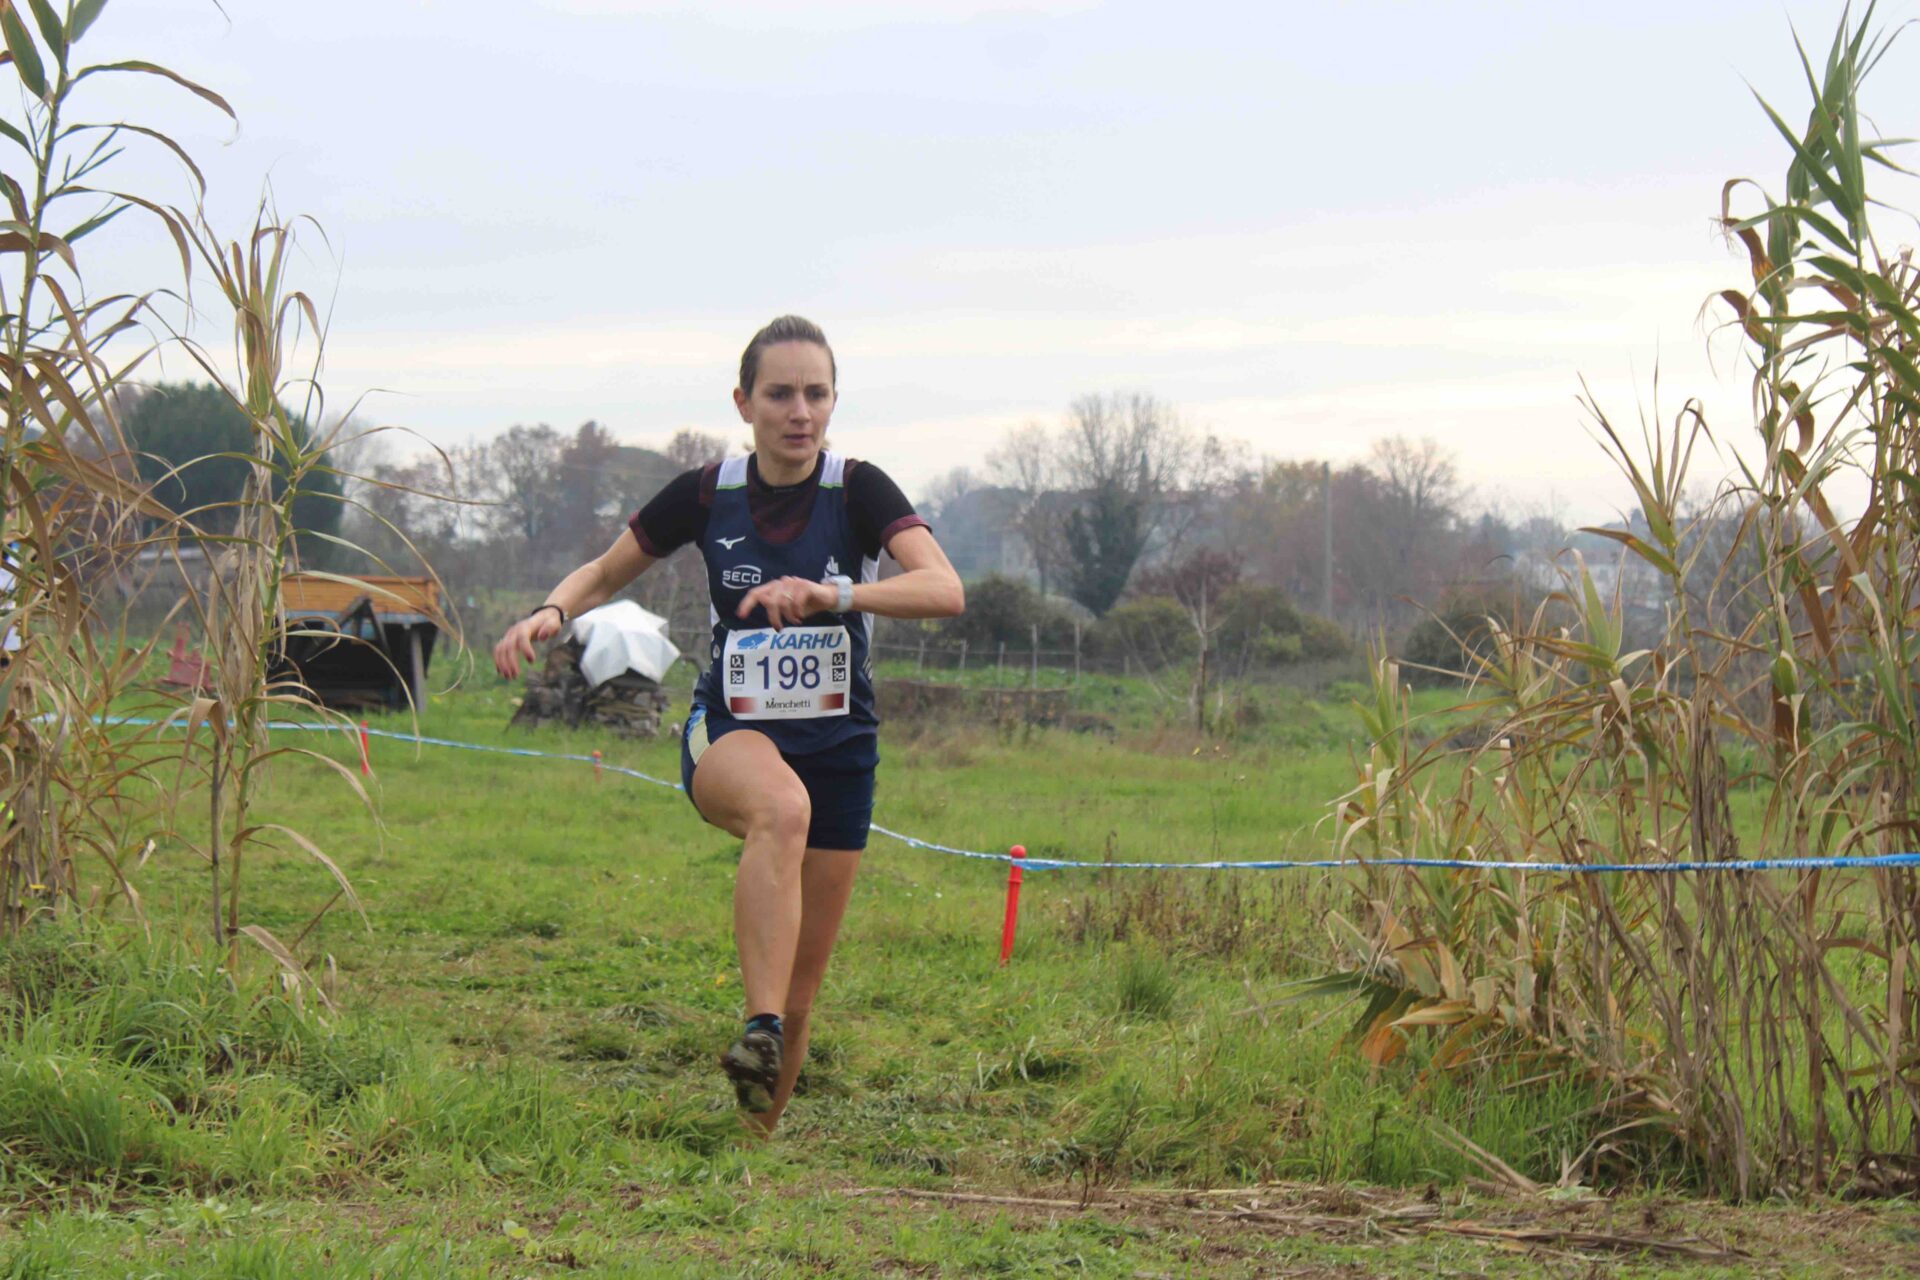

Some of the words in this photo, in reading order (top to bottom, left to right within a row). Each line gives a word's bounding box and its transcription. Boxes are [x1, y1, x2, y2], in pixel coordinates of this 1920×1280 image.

[722, 570, 762, 584] SECO
[770, 632, 844, 649] KARHU
[756, 655, 821, 690] 198
[765, 697, 811, 709] Menchetti
